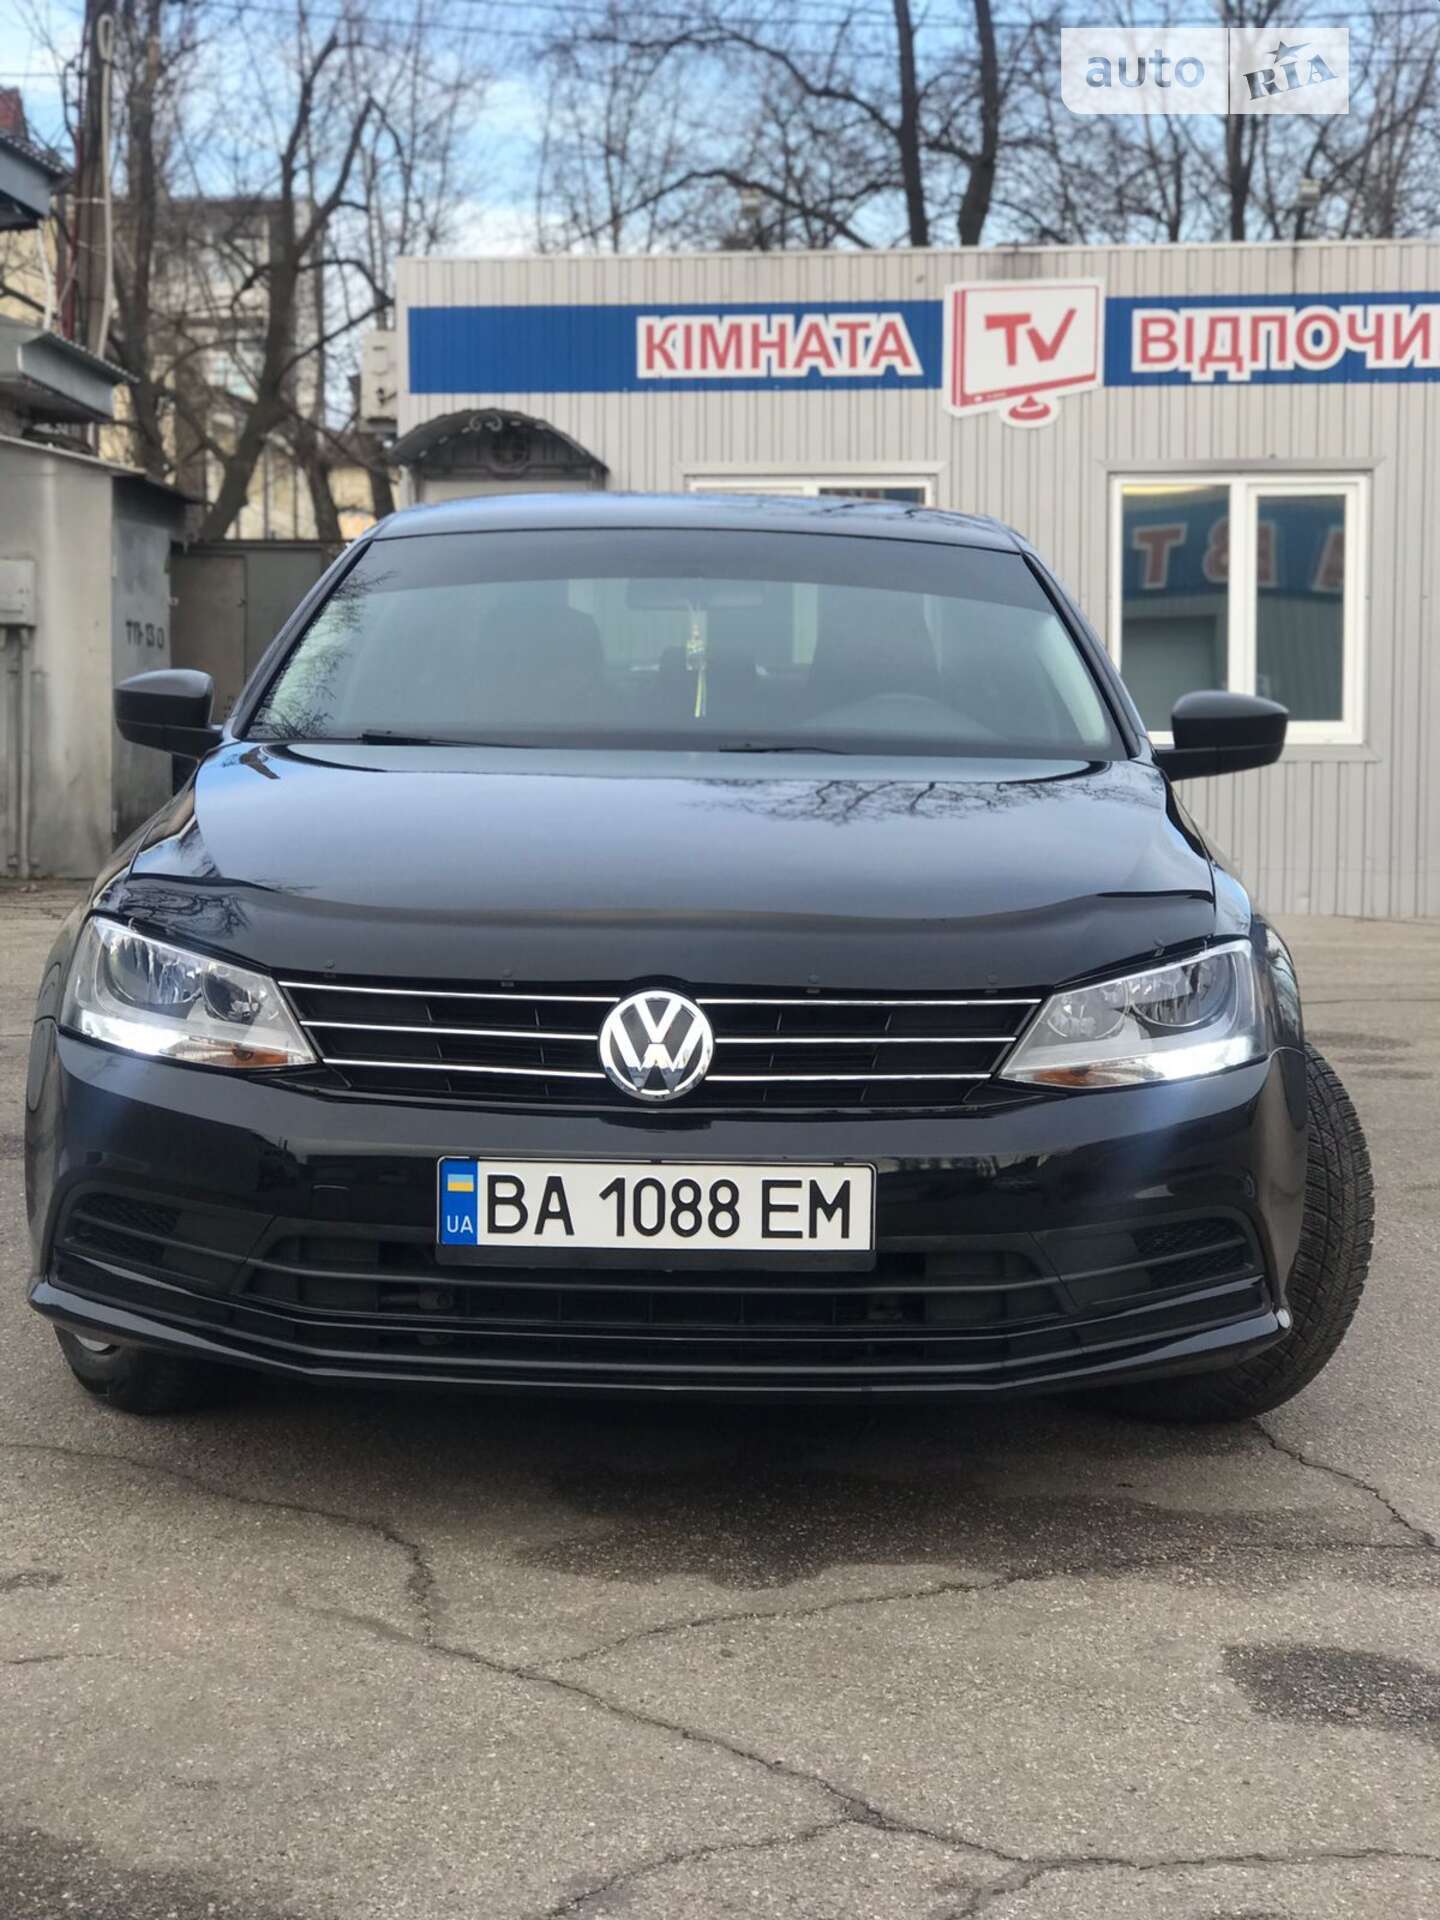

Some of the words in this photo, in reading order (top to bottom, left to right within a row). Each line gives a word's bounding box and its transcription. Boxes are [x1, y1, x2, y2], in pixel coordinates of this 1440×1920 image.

[643, 316, 913, 371] КІМНАТА
[1138, 310, 1431, 376] ВІДПОЧИ
[984, 308, 1077, 366] TV
[447, 1215, 473, 1234] UA
[487, 1174, 575, 1236] BA
[599, 1177, 740, 1239] 1088
[761, 1179, 850, 1239] EM
